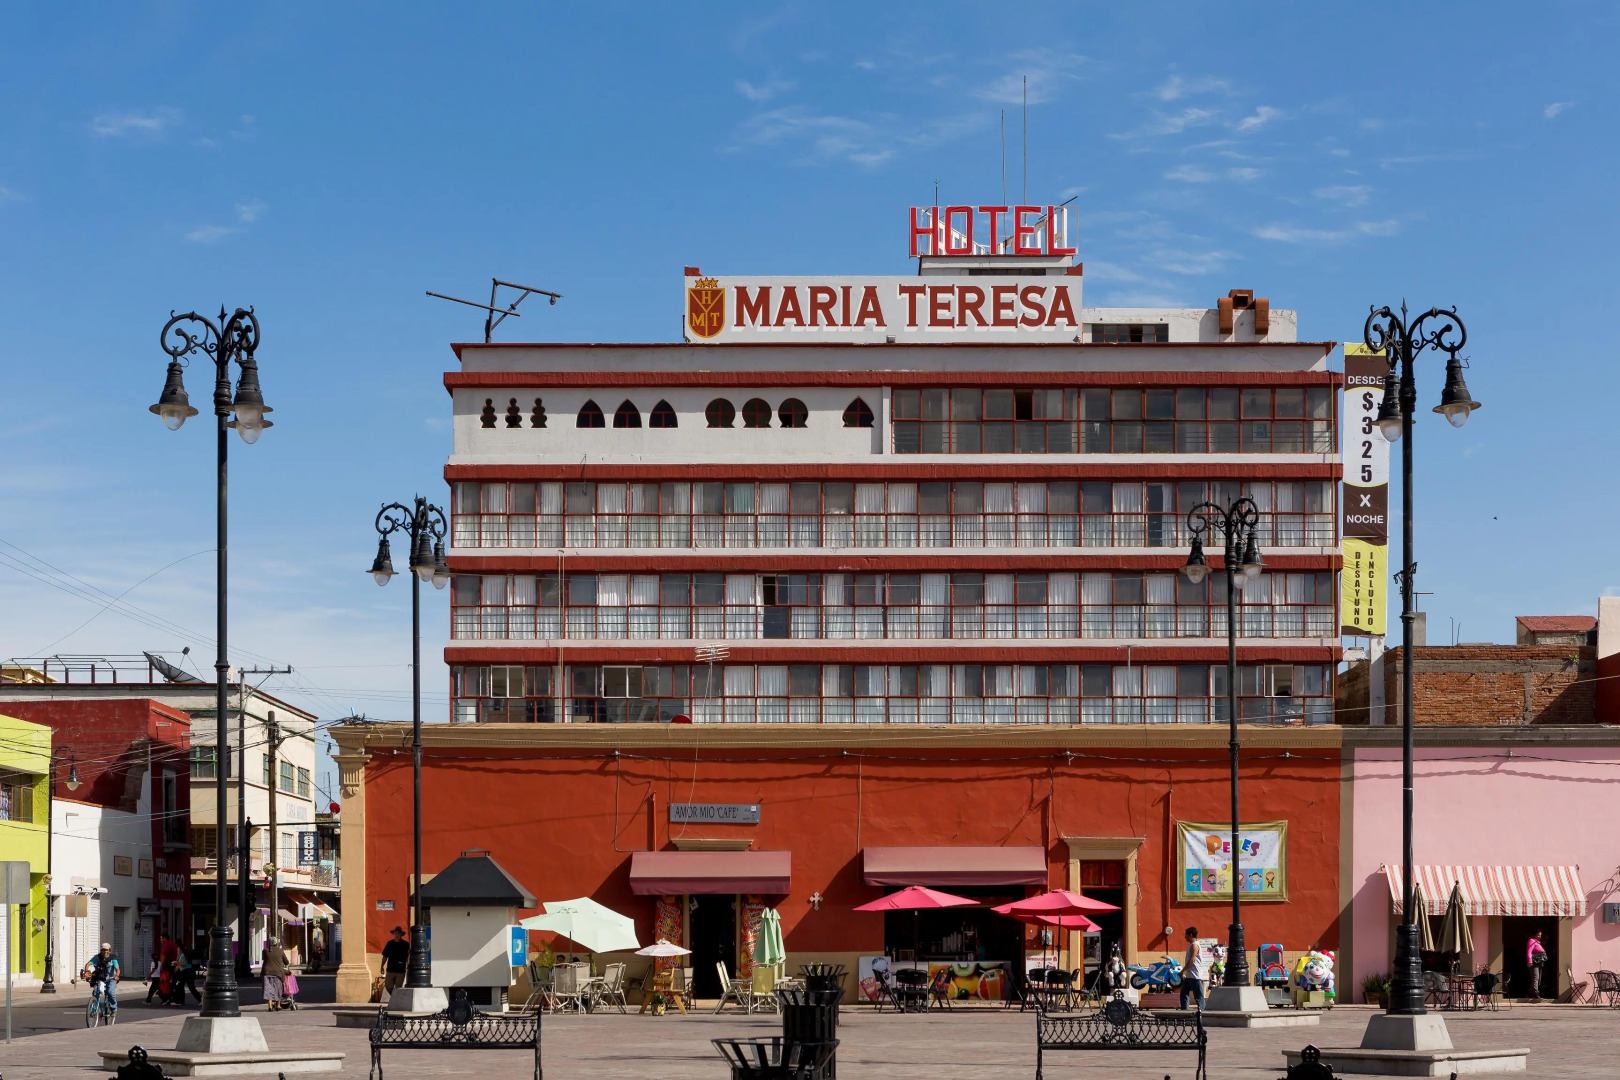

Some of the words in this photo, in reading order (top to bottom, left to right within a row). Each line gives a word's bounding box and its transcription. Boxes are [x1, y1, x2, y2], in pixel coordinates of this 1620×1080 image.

[909, 205, 1077, 256] HOTEL
[701, 291, 713, 305] H
[733, 285, 887, 328] MARIA
[898, 283, 1079, 329] TERESA
[691, 312, 706, 327] M
[710, 312, 720, 327] T
[1359, 494, 1371, 508] X
[1346, 514, 1384, 524] NOCHE
[1353, 551, 1361, 626] DESAYUNO
[1367, 551, 1375, 626] INCLUIDO
[675, 806, 698, 819] AMOR
[700, 806, 715, 819] MIO
[157, 872, 186, 892] HIDALGO
